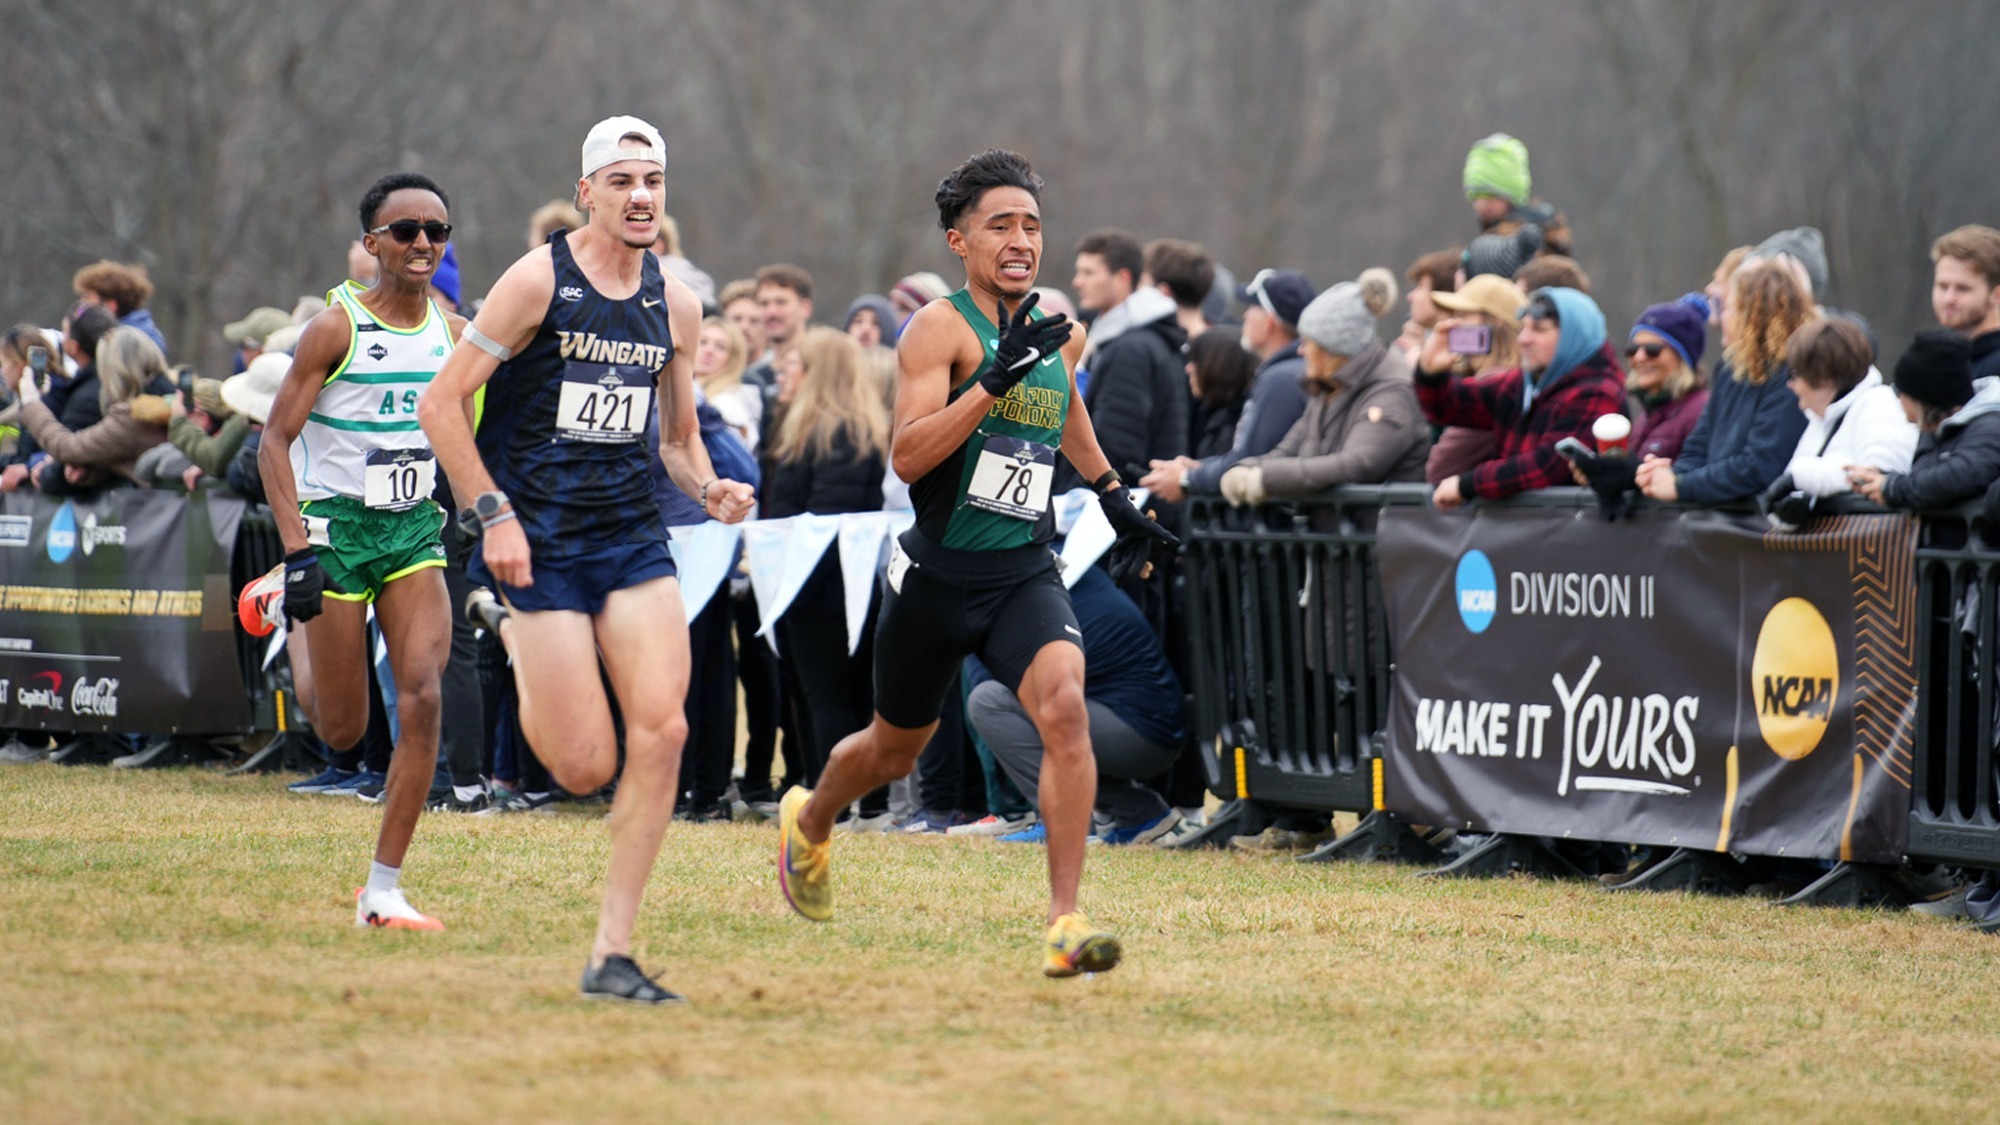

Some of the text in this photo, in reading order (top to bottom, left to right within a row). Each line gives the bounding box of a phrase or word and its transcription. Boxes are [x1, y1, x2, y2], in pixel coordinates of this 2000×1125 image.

[562, 286, 583, 299] SAC
[556, 331, 667, 372] WINGATE
[576, 391, 633, 432] 421
[989, 397, 1062, 430] POMONA
[1005, 382, 1064, 411] AL POLY
[388, 467, 418, 502] 10
[995, 464, 1032, 506] 78
[1460, 589, 1496, 613] NCAA
[1511, 571, 1654, 619] DIVISION II
[1762, 674, 1832, 722] NCAA
[1416, 655, 1698, 796] MAKE IT YOURS
